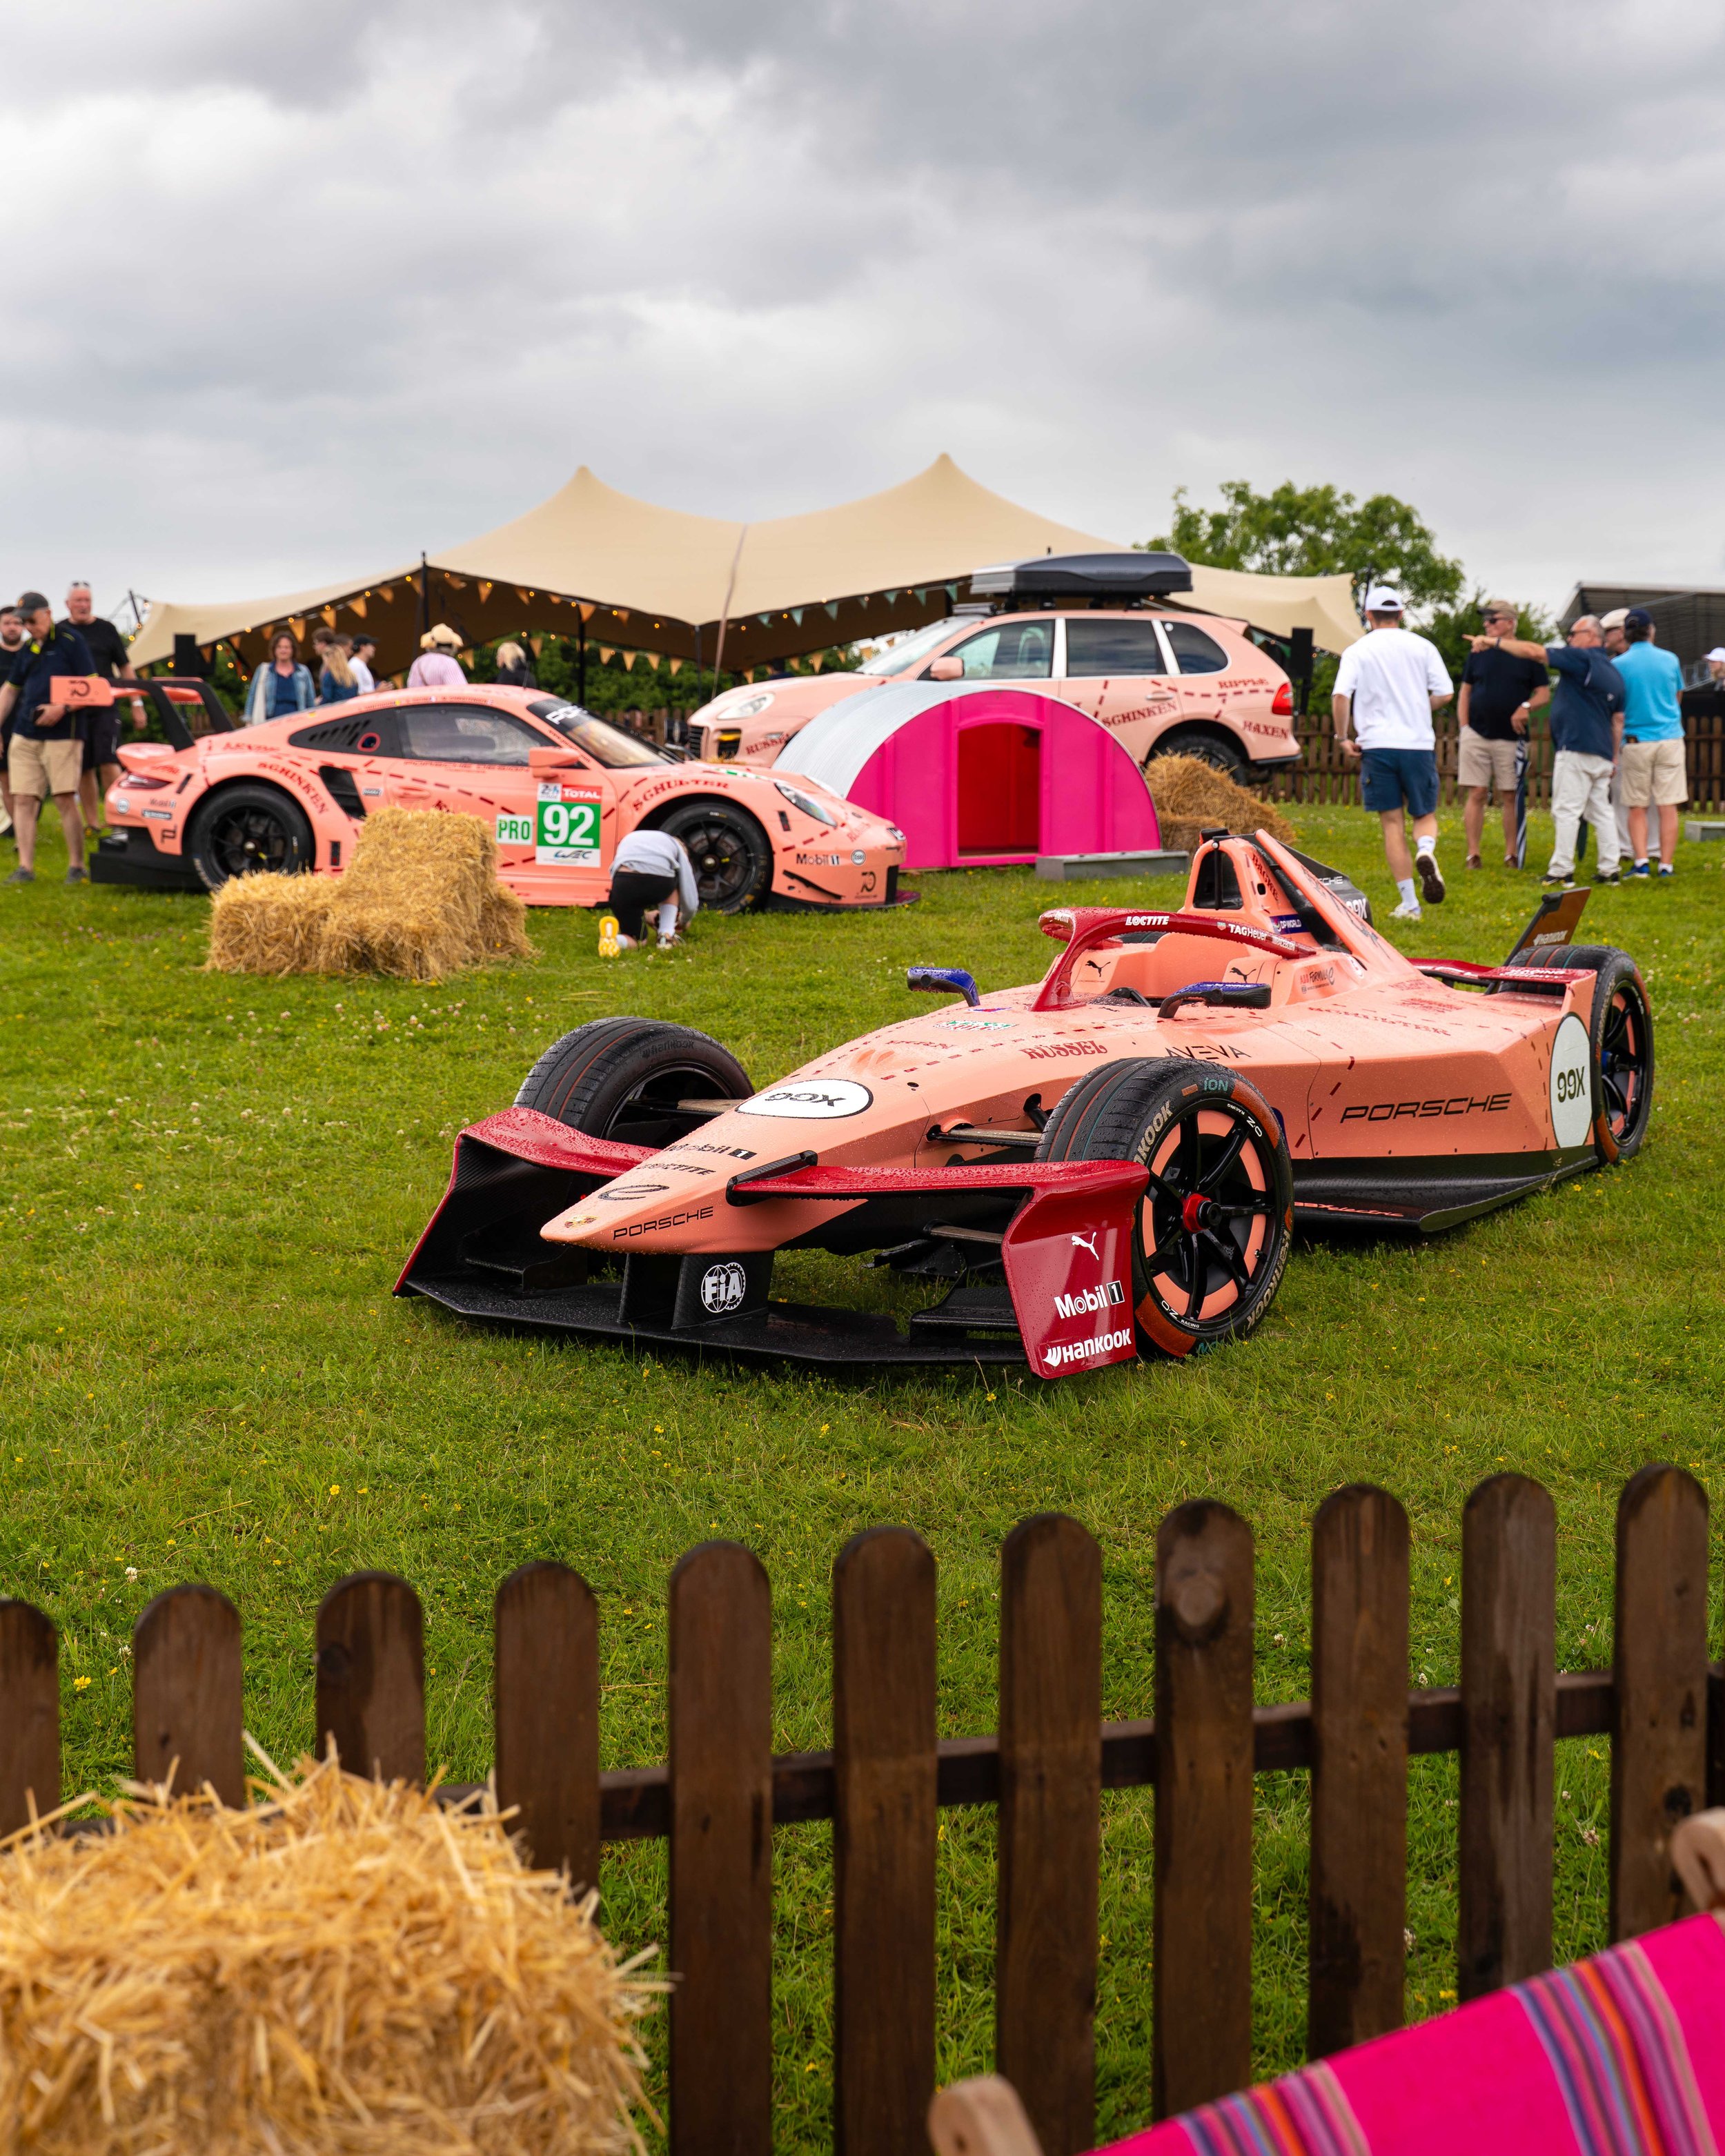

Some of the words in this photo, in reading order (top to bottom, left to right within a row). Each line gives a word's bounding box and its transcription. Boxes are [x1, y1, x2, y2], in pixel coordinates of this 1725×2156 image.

[1243, 720, 1290, 740] HAXEN
[562, 788, 601, 800] TOTAL
[498, 820, 531, 840] PRO
[543, 804, 595, 846] 92
[796, 853, 829, 865] Mobil
[1125, 915, 1170, 927] LOCTITE
[1228, 923, 1248, 936] TAG
[1018, 1040, 1108, 1060] RÜSSEL
[1165, 1045, 1252, 1060] AVEVA
[1557, 1065, 1586, 1103] 99X
[765, 1093, 847, 1107] 99X
[1340, 1093, 1512, 1124] PORSCHE
[613, 1206, 714, 1240] PORSCHE
[1054, 1285, 1108, 1319] Mobil
[1181, 1318, 1200, 1329] RACING
